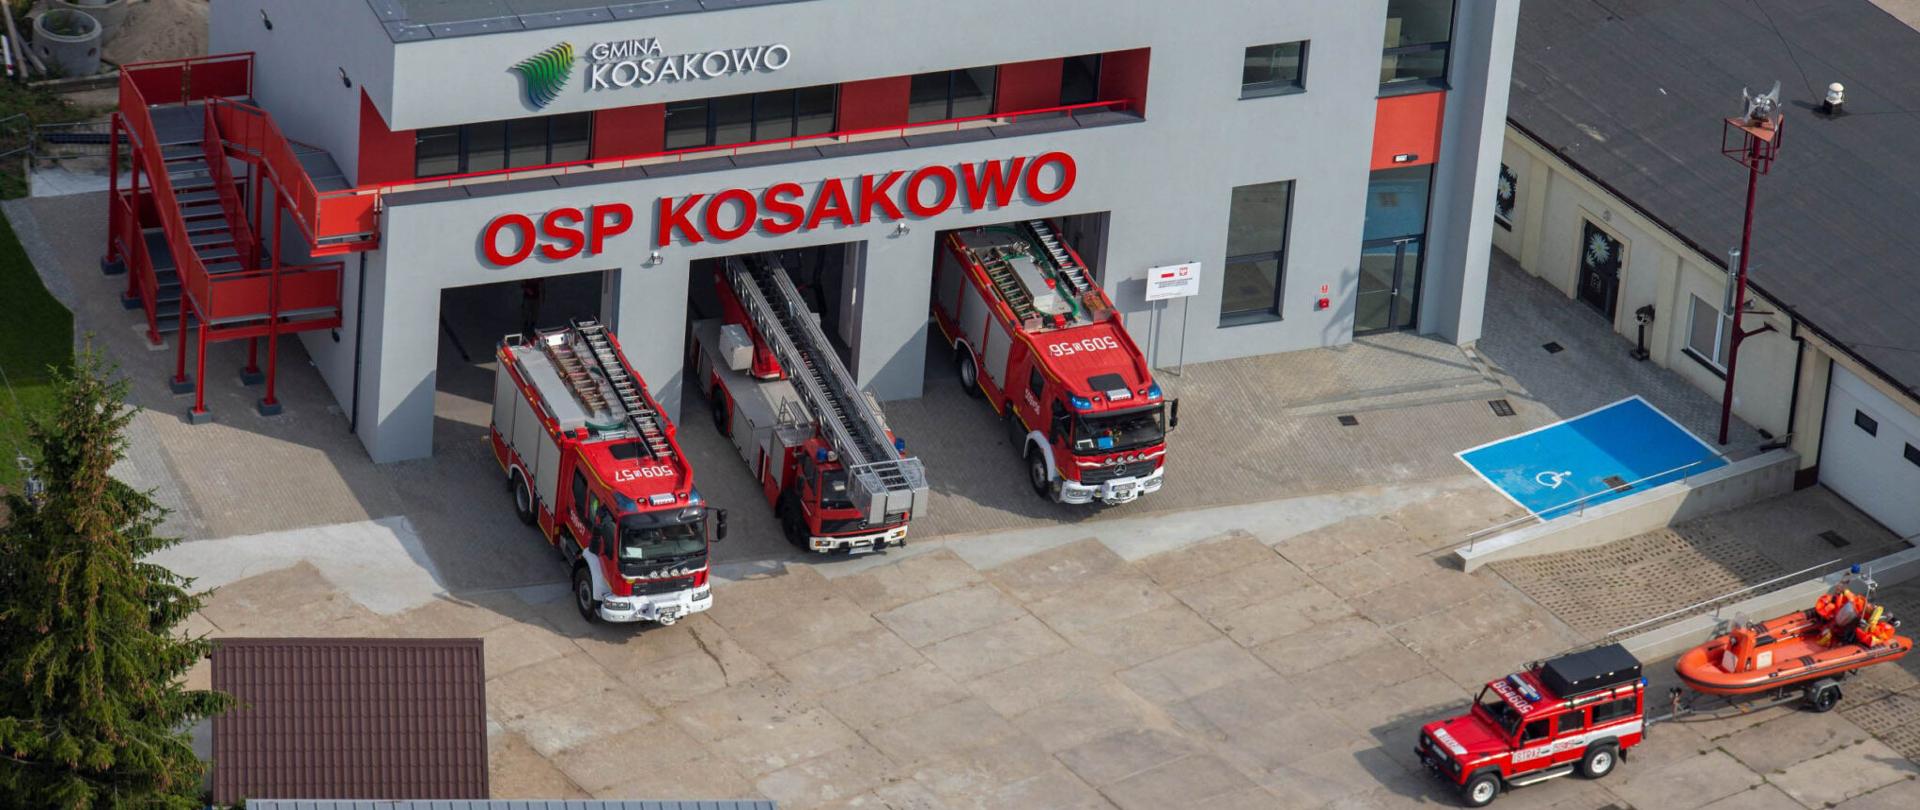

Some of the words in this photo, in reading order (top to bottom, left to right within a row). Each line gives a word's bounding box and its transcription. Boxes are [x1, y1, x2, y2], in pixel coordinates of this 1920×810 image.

[592, 37, 662, 61] GMINA
[592, 43, 790, 89] KOSAKOWO
[483, 202, 633, 267] OSP
[657, 151, 1077, 247] KOSAKOWO
